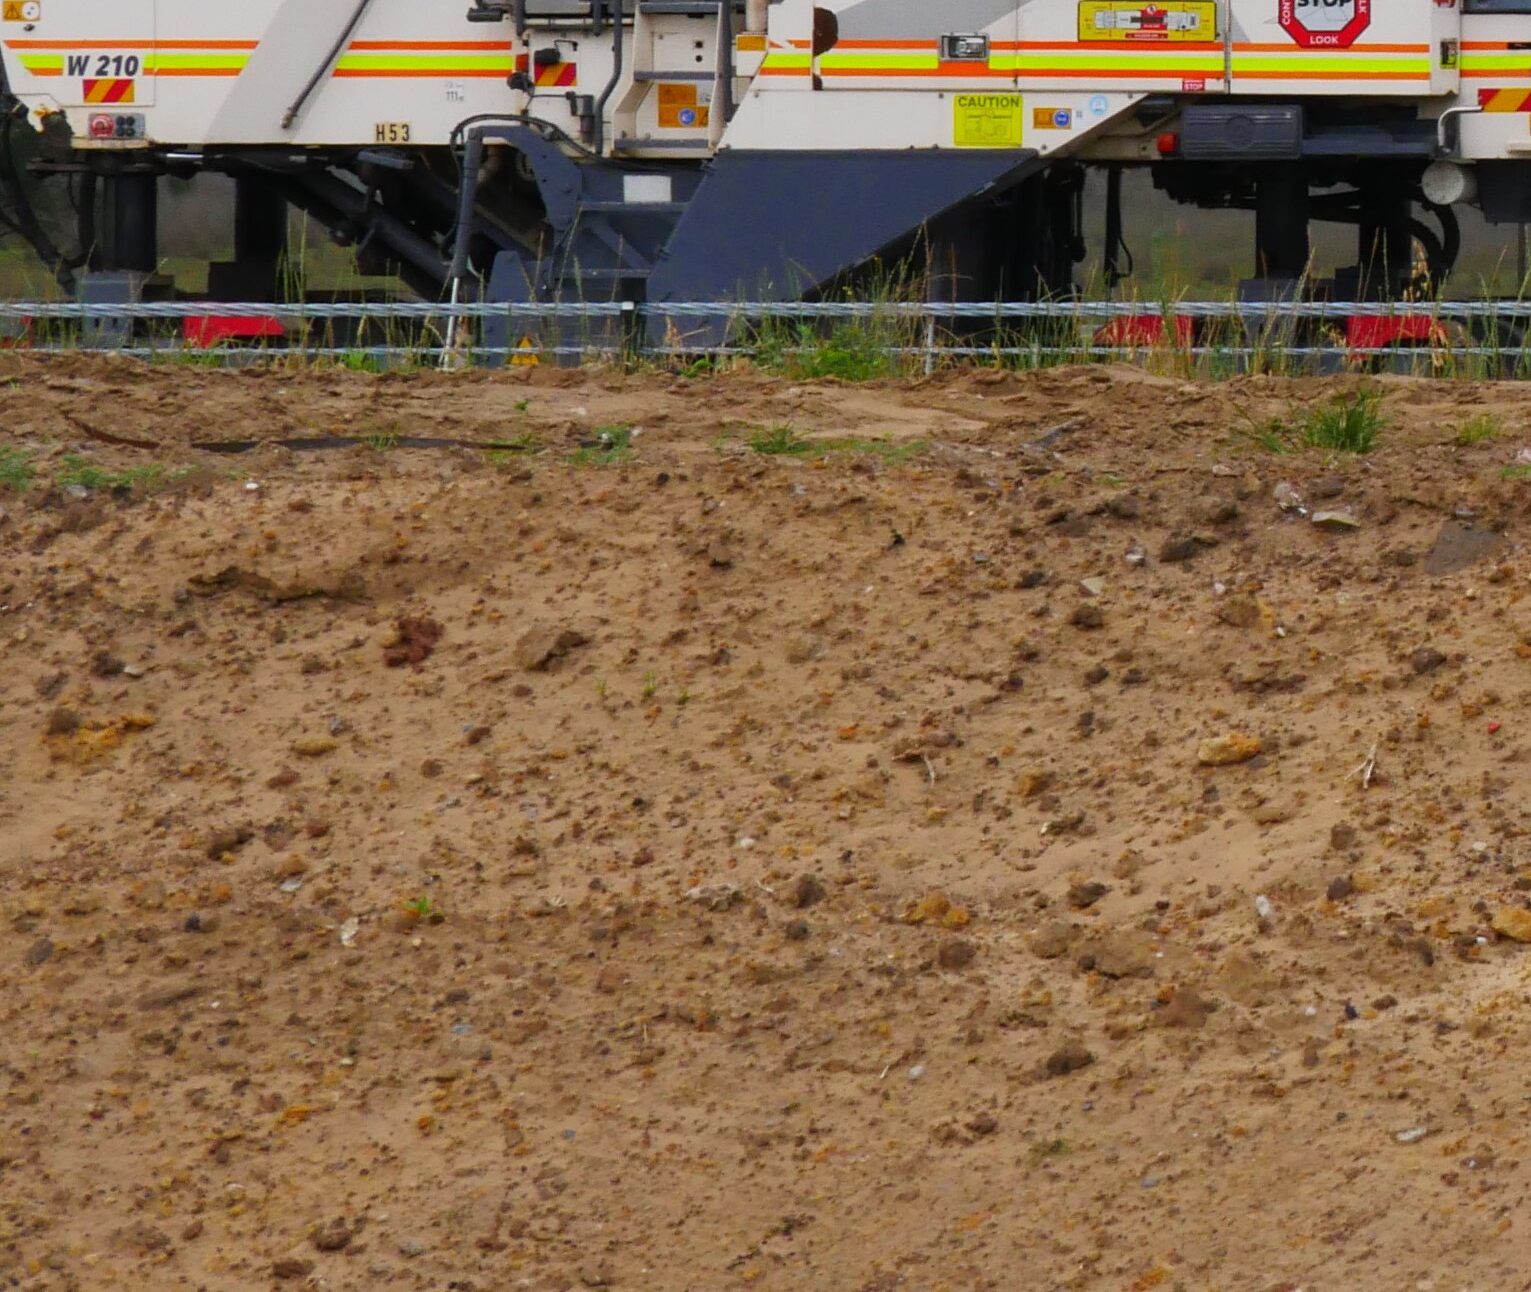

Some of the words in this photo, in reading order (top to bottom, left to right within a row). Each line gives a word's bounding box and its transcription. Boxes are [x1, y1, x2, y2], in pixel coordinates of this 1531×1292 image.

[1309, 35, 1338, 45] LOOK
[67, 55, 90, 76] W
[95, 55, 139, 77] 210
[958, 96, 1020, 108] CAUTION
